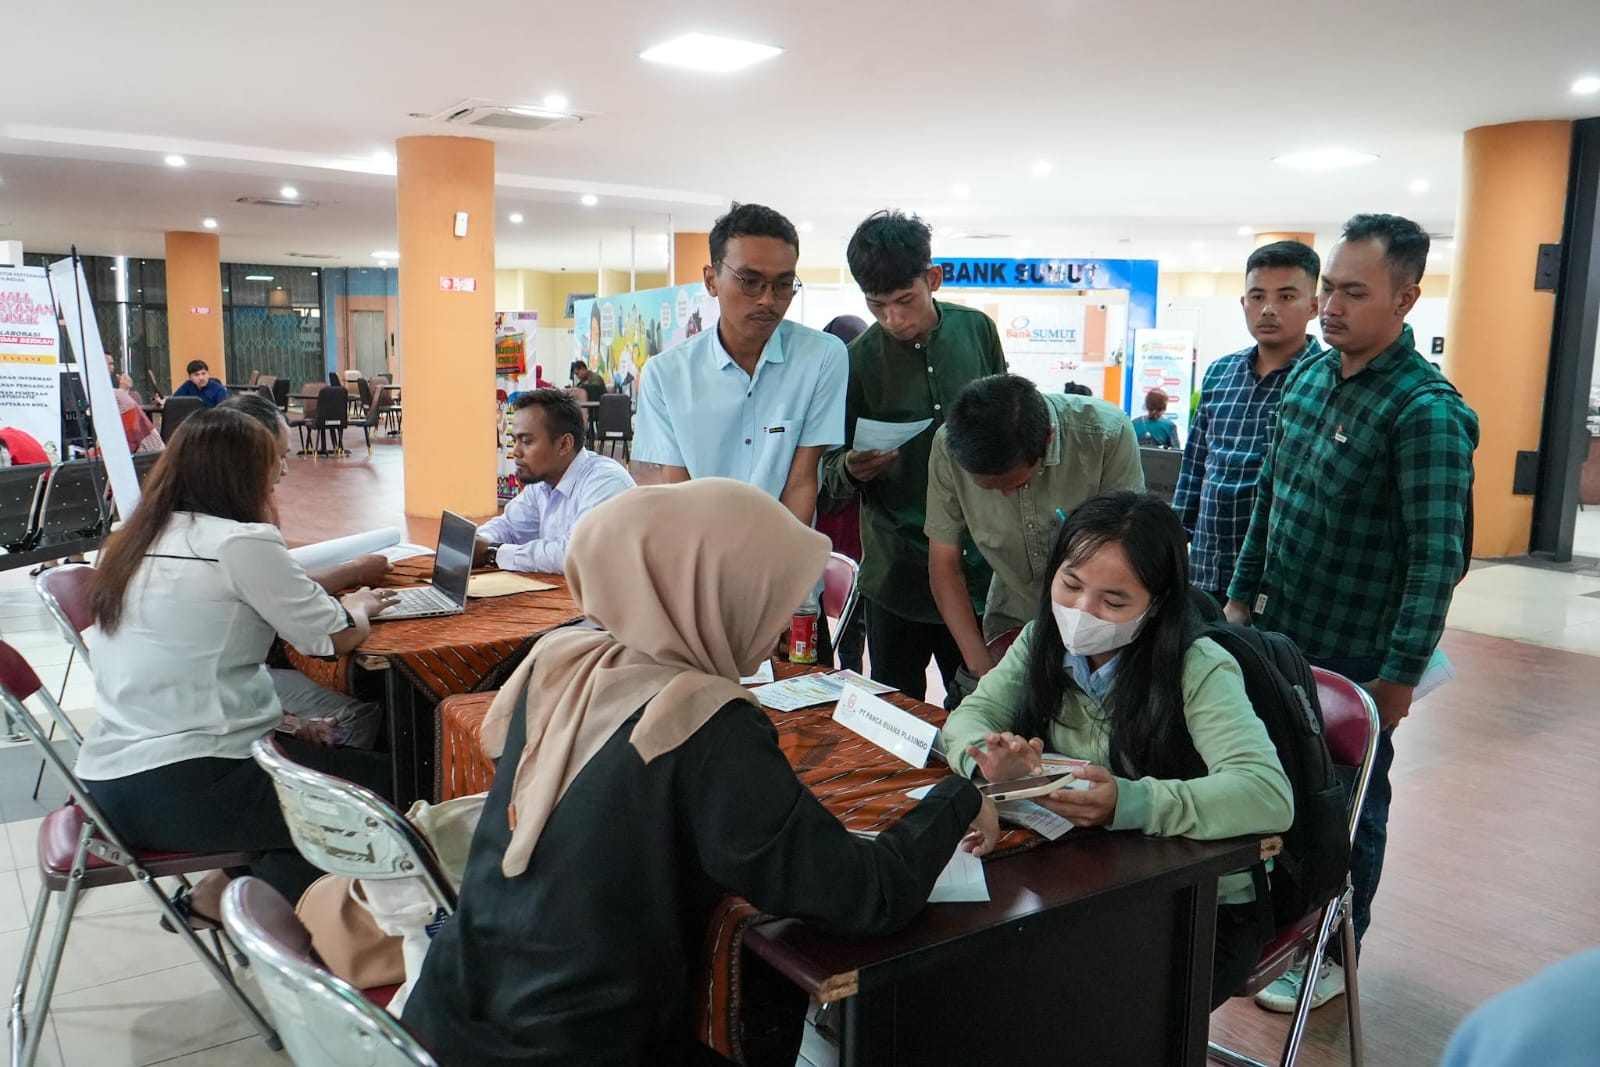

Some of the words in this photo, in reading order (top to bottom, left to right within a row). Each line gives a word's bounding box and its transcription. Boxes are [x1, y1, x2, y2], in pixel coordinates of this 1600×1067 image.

[941, 262, 1006, 283] BANK
[1014, 263, 1098, 284] SUMUT
[866, 711, 882, 726] PANCA
[882, 721, 901, 736] BUANA
[901, 730, 928, 750] PLASINDO
